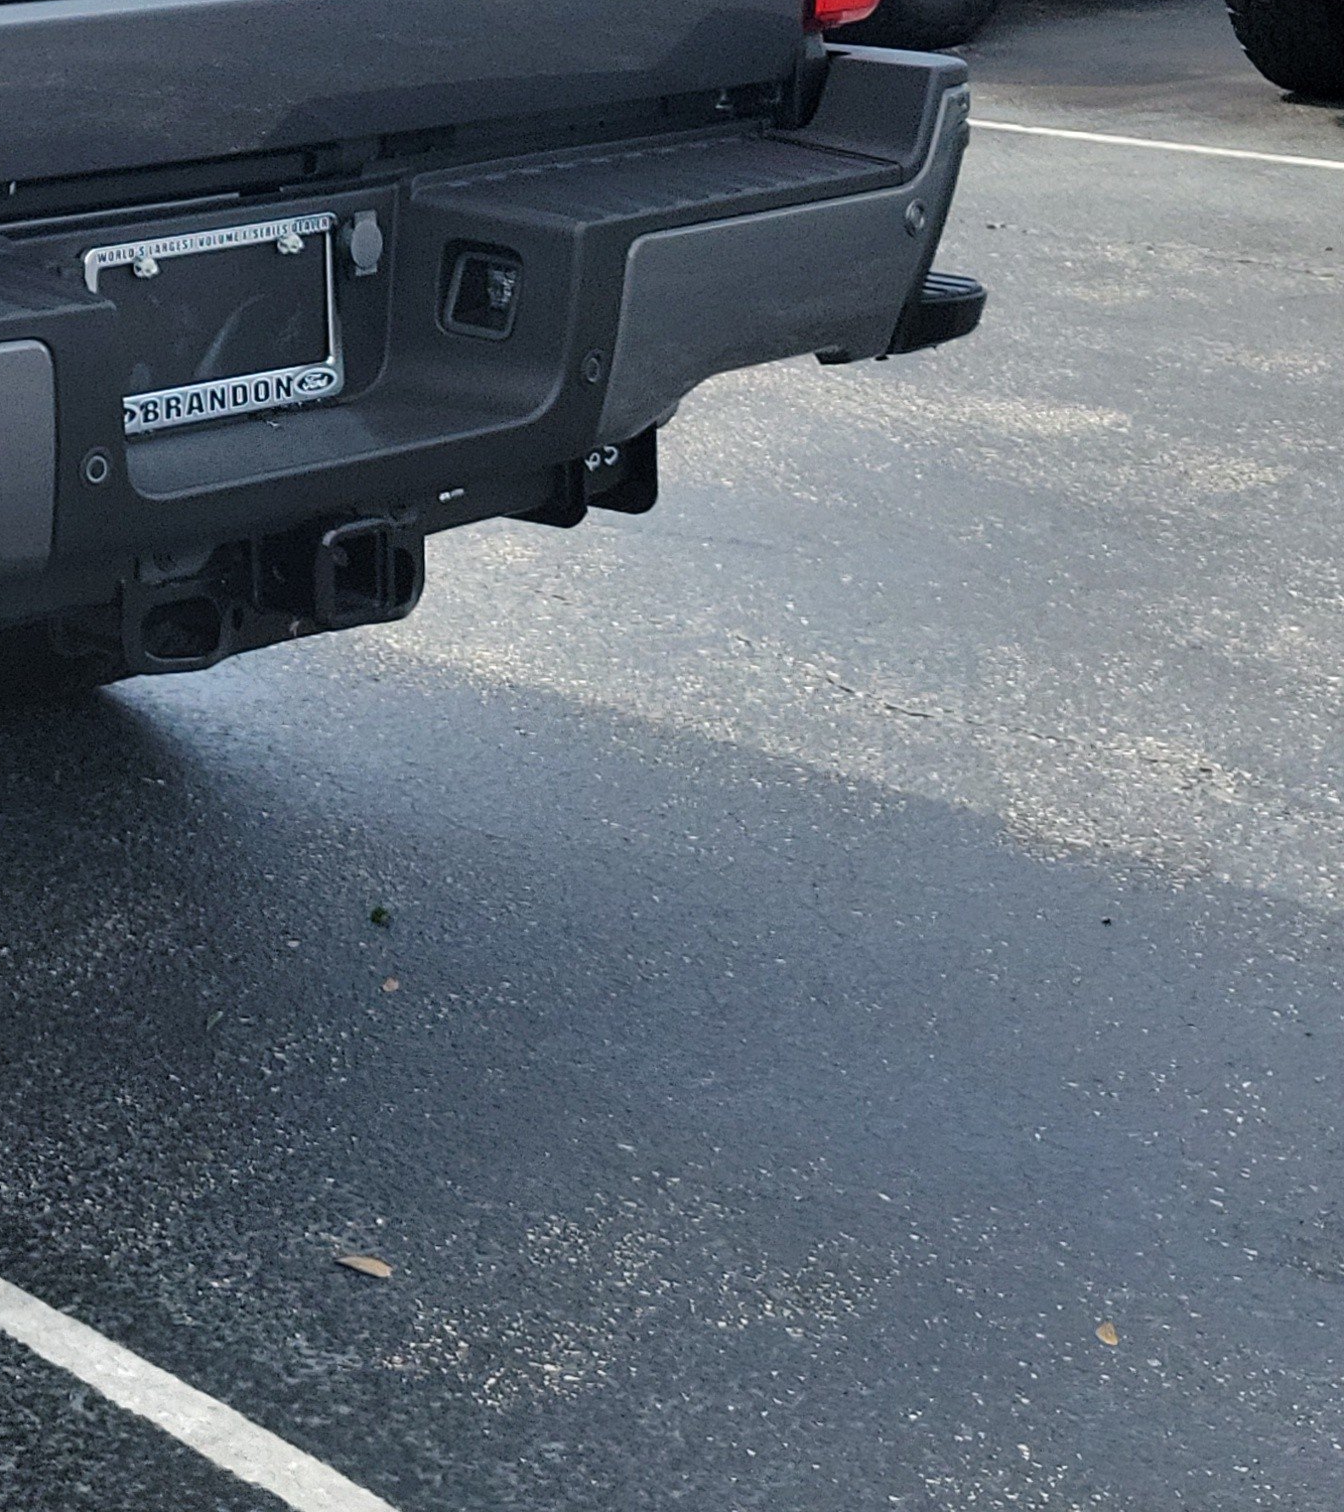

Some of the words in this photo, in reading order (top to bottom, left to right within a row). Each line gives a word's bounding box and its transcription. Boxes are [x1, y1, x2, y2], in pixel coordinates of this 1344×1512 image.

[149, 238, 194, 256] LARGEST
[198, 231, 240, 248] VOLUME
[140, 375, 293, 423] BRANDON
